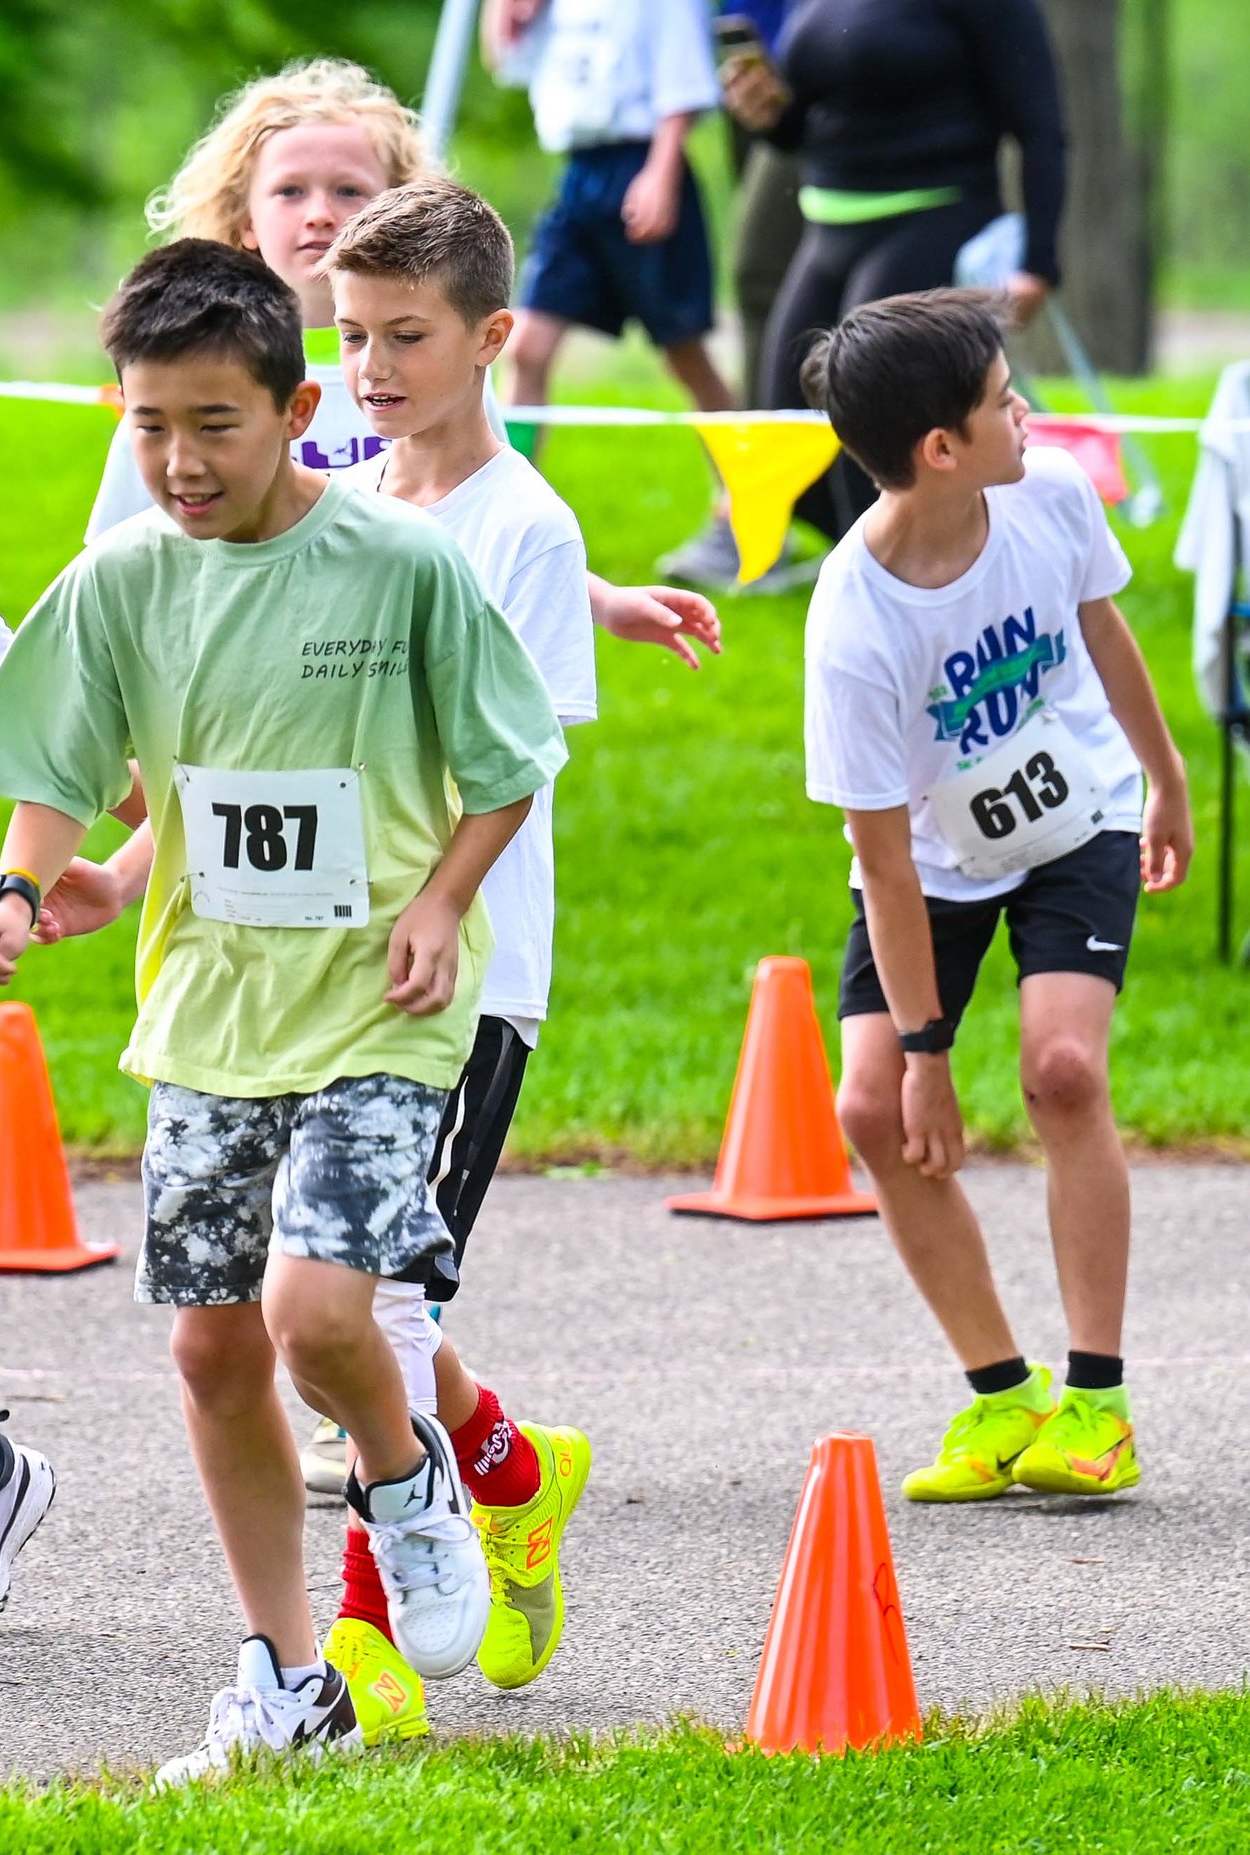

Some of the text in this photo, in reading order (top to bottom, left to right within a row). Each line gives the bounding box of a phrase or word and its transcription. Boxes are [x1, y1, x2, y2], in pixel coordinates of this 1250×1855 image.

[301, 660, 364, 679] DAILY
[944, 605, 1036, 700] RUN
[968, 751, 1069, 840] 613
[211, 802, 318, 872] 787
